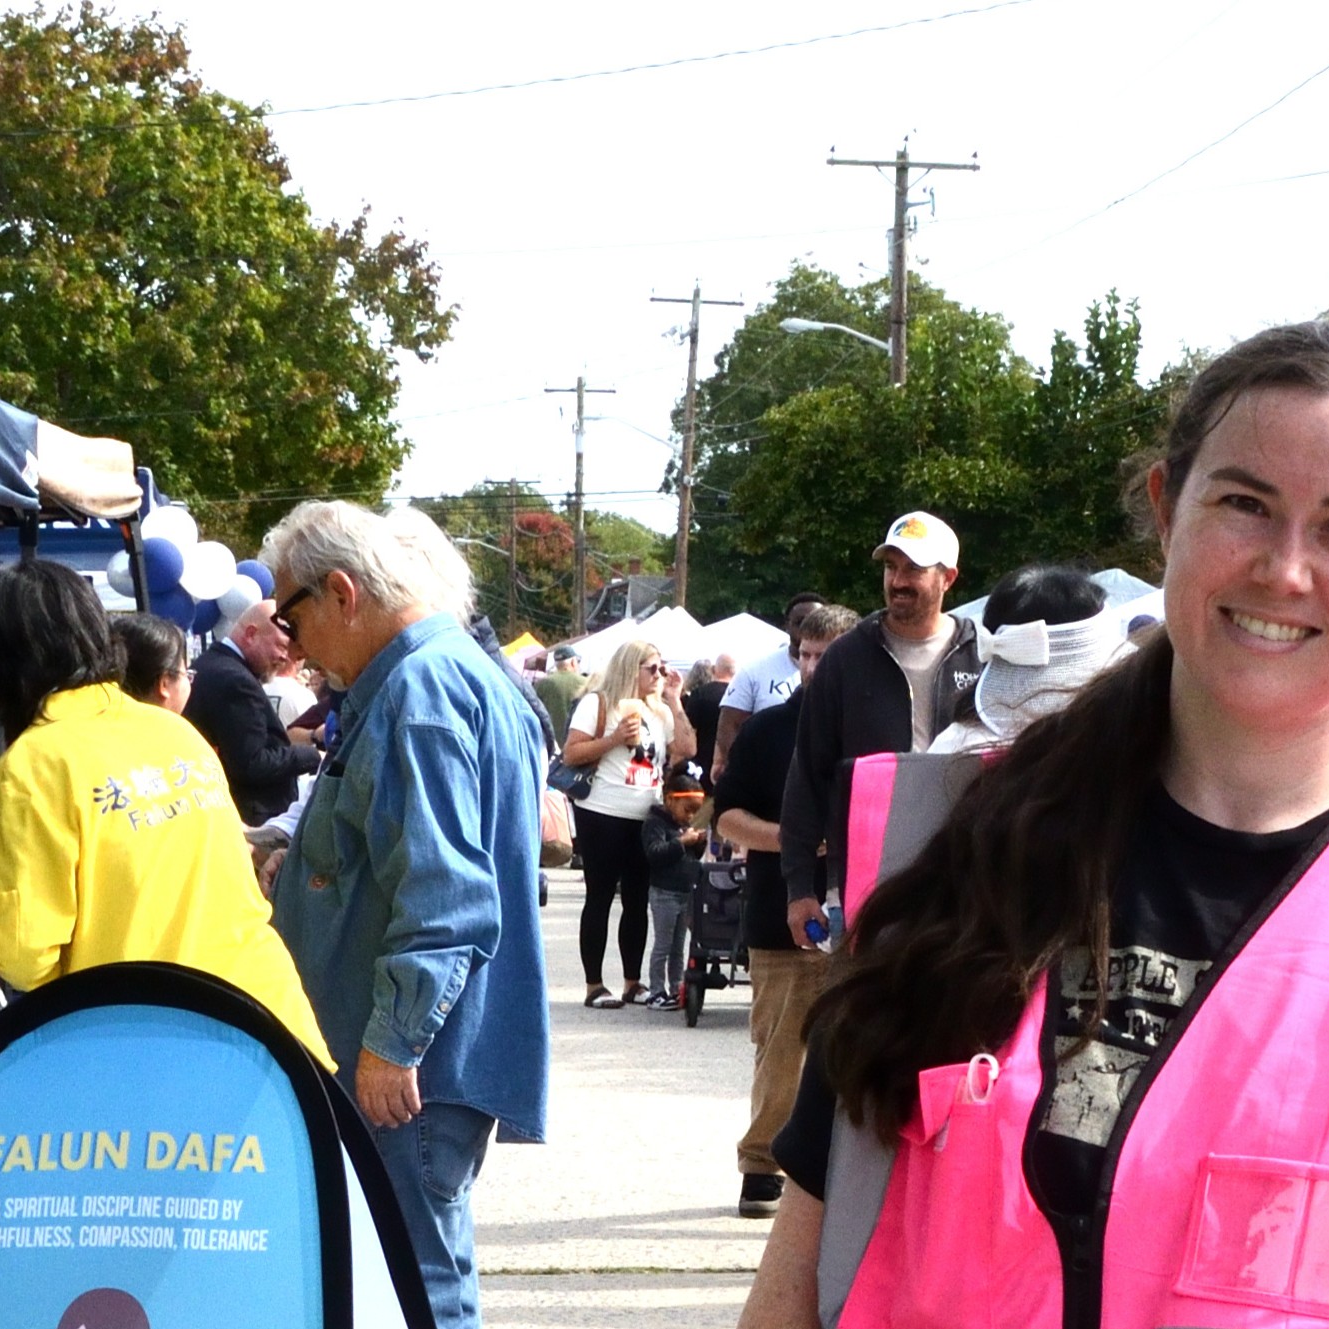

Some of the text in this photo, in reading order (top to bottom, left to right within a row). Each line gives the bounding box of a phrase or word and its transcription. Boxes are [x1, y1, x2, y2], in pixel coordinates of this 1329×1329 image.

[145, 1131, 266, 1174] DAFA
[4, 1196, 78, 1219] SPIRITUAL
[81, 1196, 162, 1219] DISCIPLINE
[164, 1198, 219, 1220] GUIDED
[222, 1199, 244, 1222] BY
[79, 1226, 178, 1250] COMPASSION,
[182, 1227, 269, 1251] TOLERANCE
